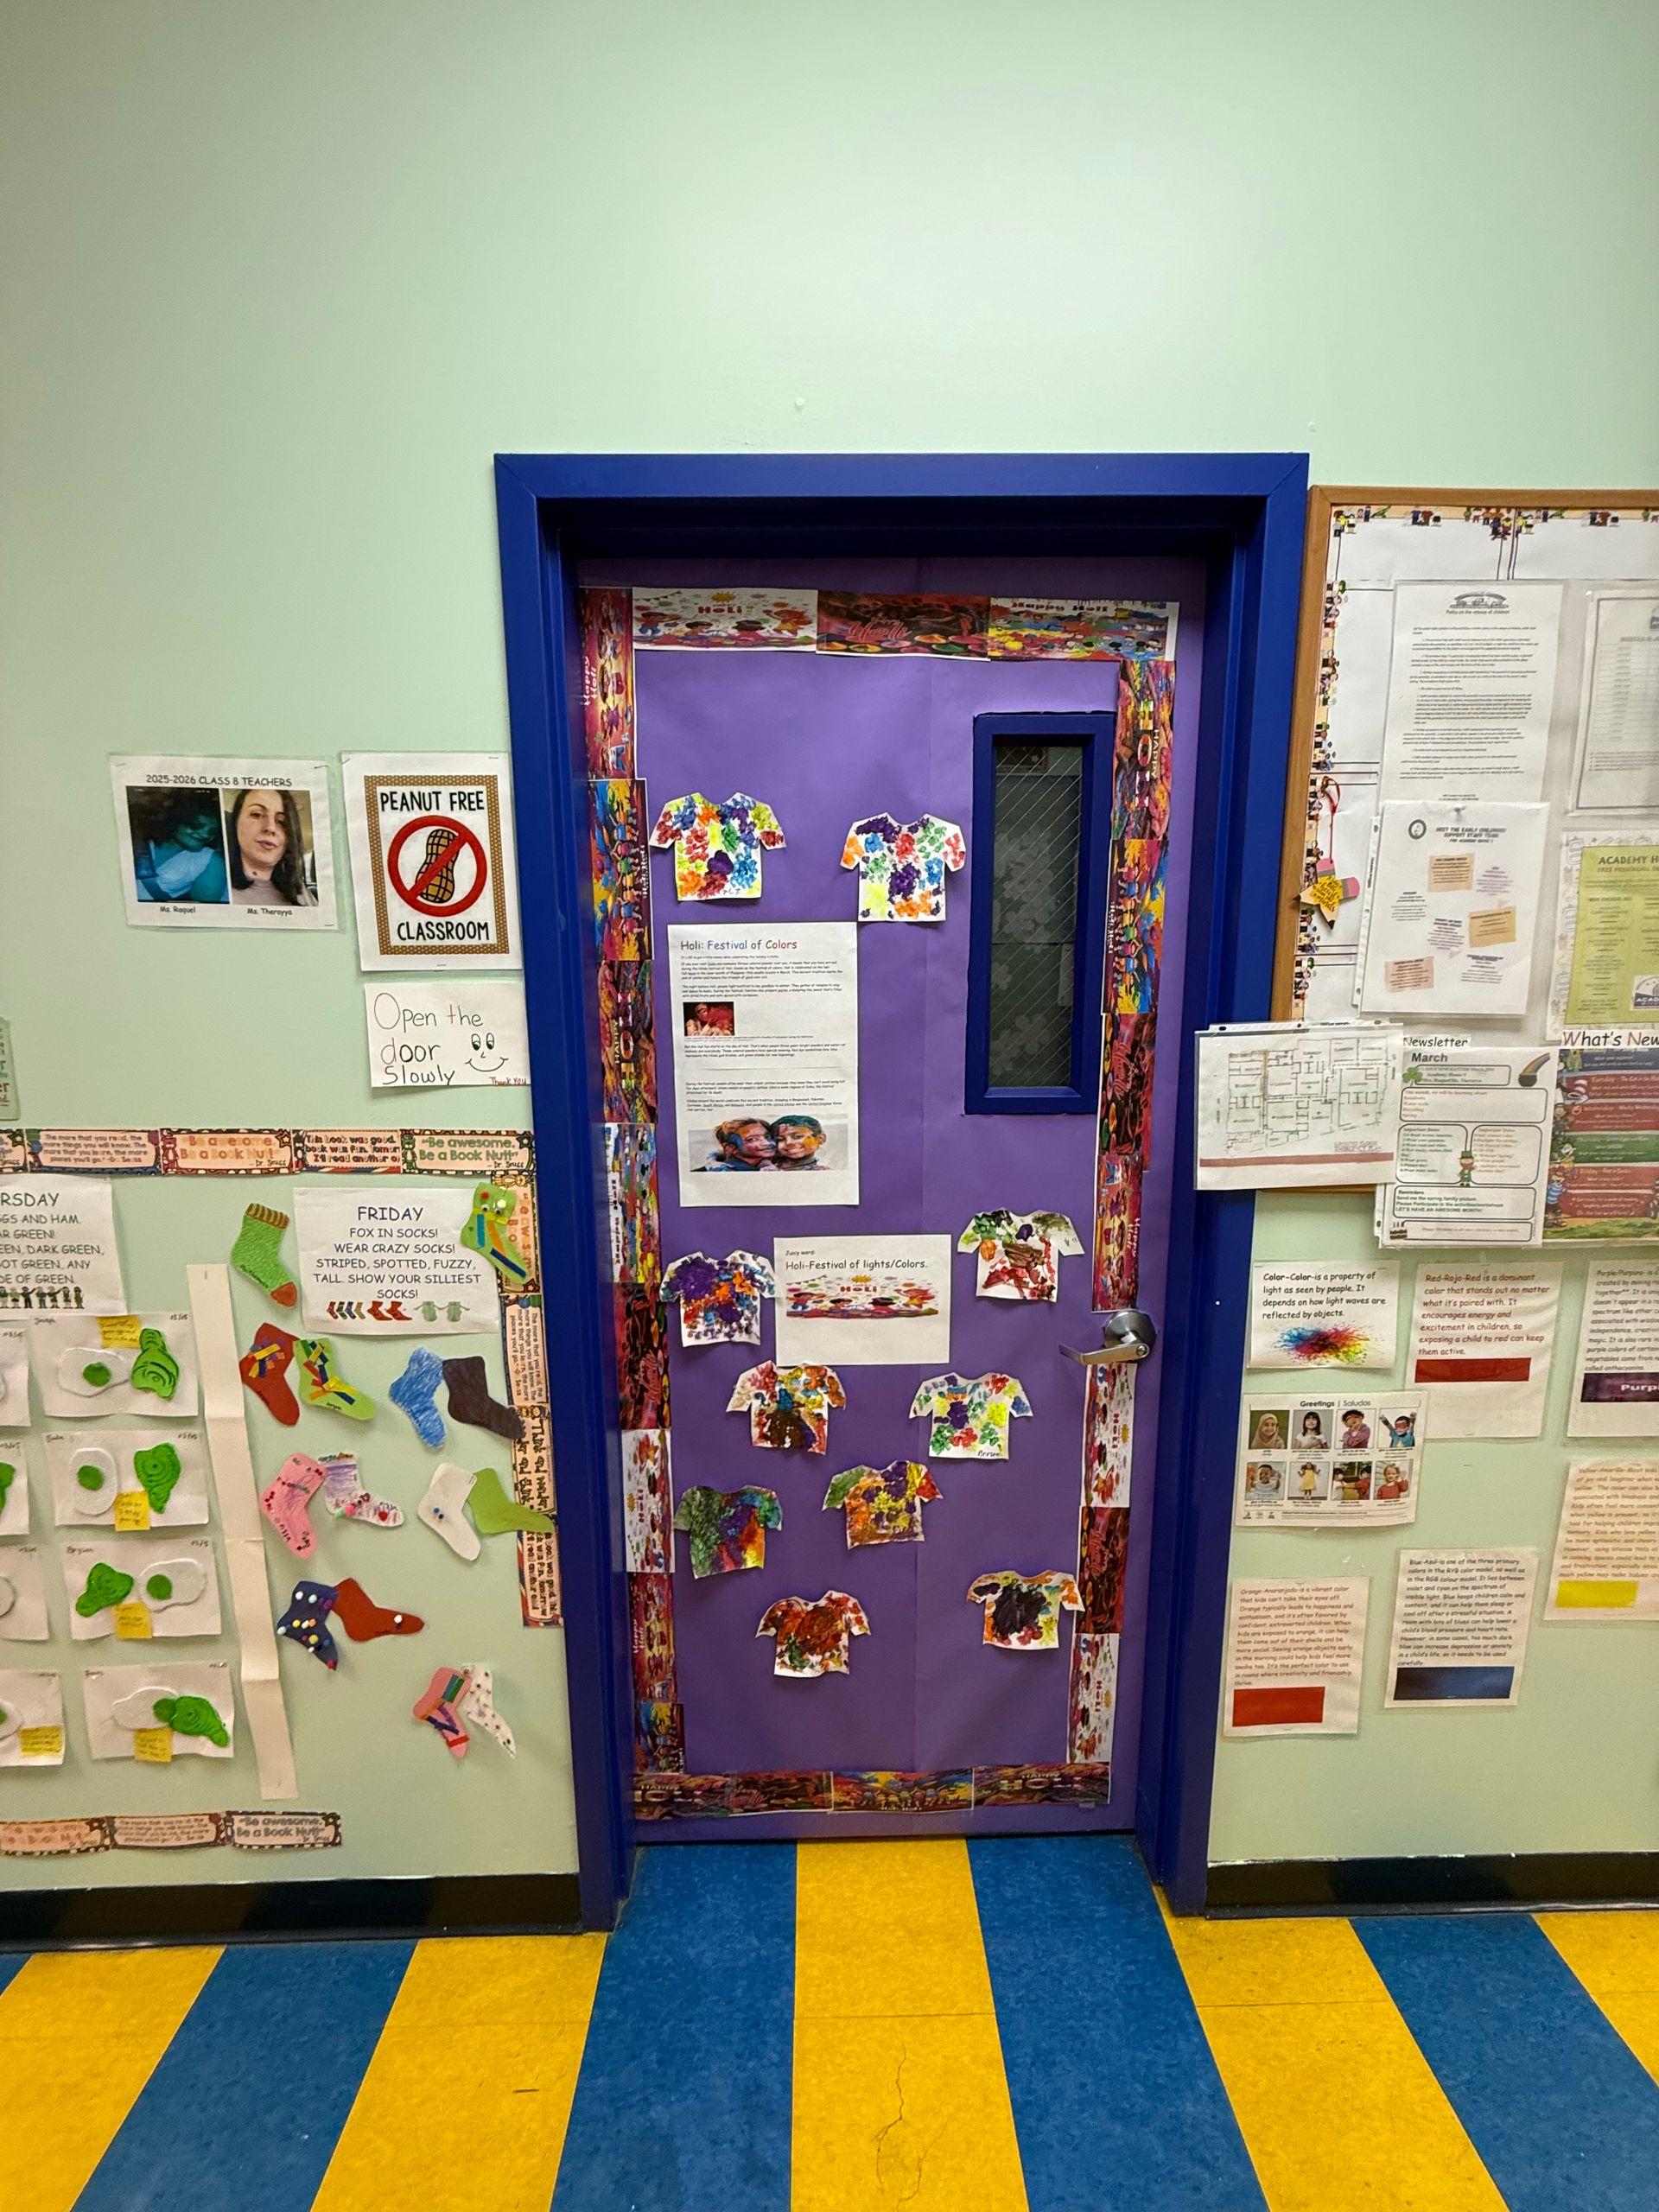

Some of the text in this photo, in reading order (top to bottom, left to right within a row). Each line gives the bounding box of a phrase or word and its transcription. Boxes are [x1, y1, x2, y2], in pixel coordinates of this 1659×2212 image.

[146, 774, 196, 785] 2025-2026
[199, 776, 230, 785] CLASS
[241, 777, 292, 787] TEACHERS
[380, 791, 485, 811] PEANUT FREE
[397, 921, 490, 942] CLASSROOM
[681, 939, 798, 950] Holi: Festival of Colors
[373, 992, 484, 1033] Open the
[1403, 1037, 1468, 1047] Newsletter
[1562, 1031, 1622, 1046] What's
[380, 1037, 442, 1064] door
[1411, 1052, 1447, 1063] March
[382, 1065, 455, 1085] Slowly
[419, 1150, 435, 1160] Be
[450, 1150, 482, 1160] Book
[22, 1214, 47, 1224] AND
[51, 1215, 81, 1224] HAM.
[358, 1206, 423, 1221] FRIDAY
[350, 1228, 438, 1238] FOX IN SOCKS!
[27, 1245, 59, 1254] DARK
[61, 1245, 105, 1255] GREEN,
[334, 1243, 455, 1254] WEAR CRAZY SOCKS!
[22, 1260, 64, 1270] GREEN,
[67, 1260, 90, 1269] ANY
[316, 1258, 475, 1270] STRIPED, SPOTTED, FUZZY,
[786, 1258, 927, 1271] Holi-Festival of lights/Colors.
[16, 1274, 31, 1283] OF
[35, 1274, 75, 1284] GREEN.
[347, 1274, 385, 1283] SHOW
[387, 1274, 422, 1283] YOUR
[424, 1274, 481, 1284] SILLIEST
[1331, 1273, 1364, 1281] property
[1426, 1274, 1481, 1284] Red-Rojo-Red
[377, 1288, 418, 1299] SOCKS!
[1263, 1287, 1281, 1295] light
[1327, 1285, 1353, 1294] people.
[1262, 1300, 1295, 1309] depends
[1325, 1298, 1344, 1306] light
[1459, 1299, 1484, 1308] paired
[1313, 1309, 1344, 1319] objects.
[1419, 1336, 1453, 1344] exposing
